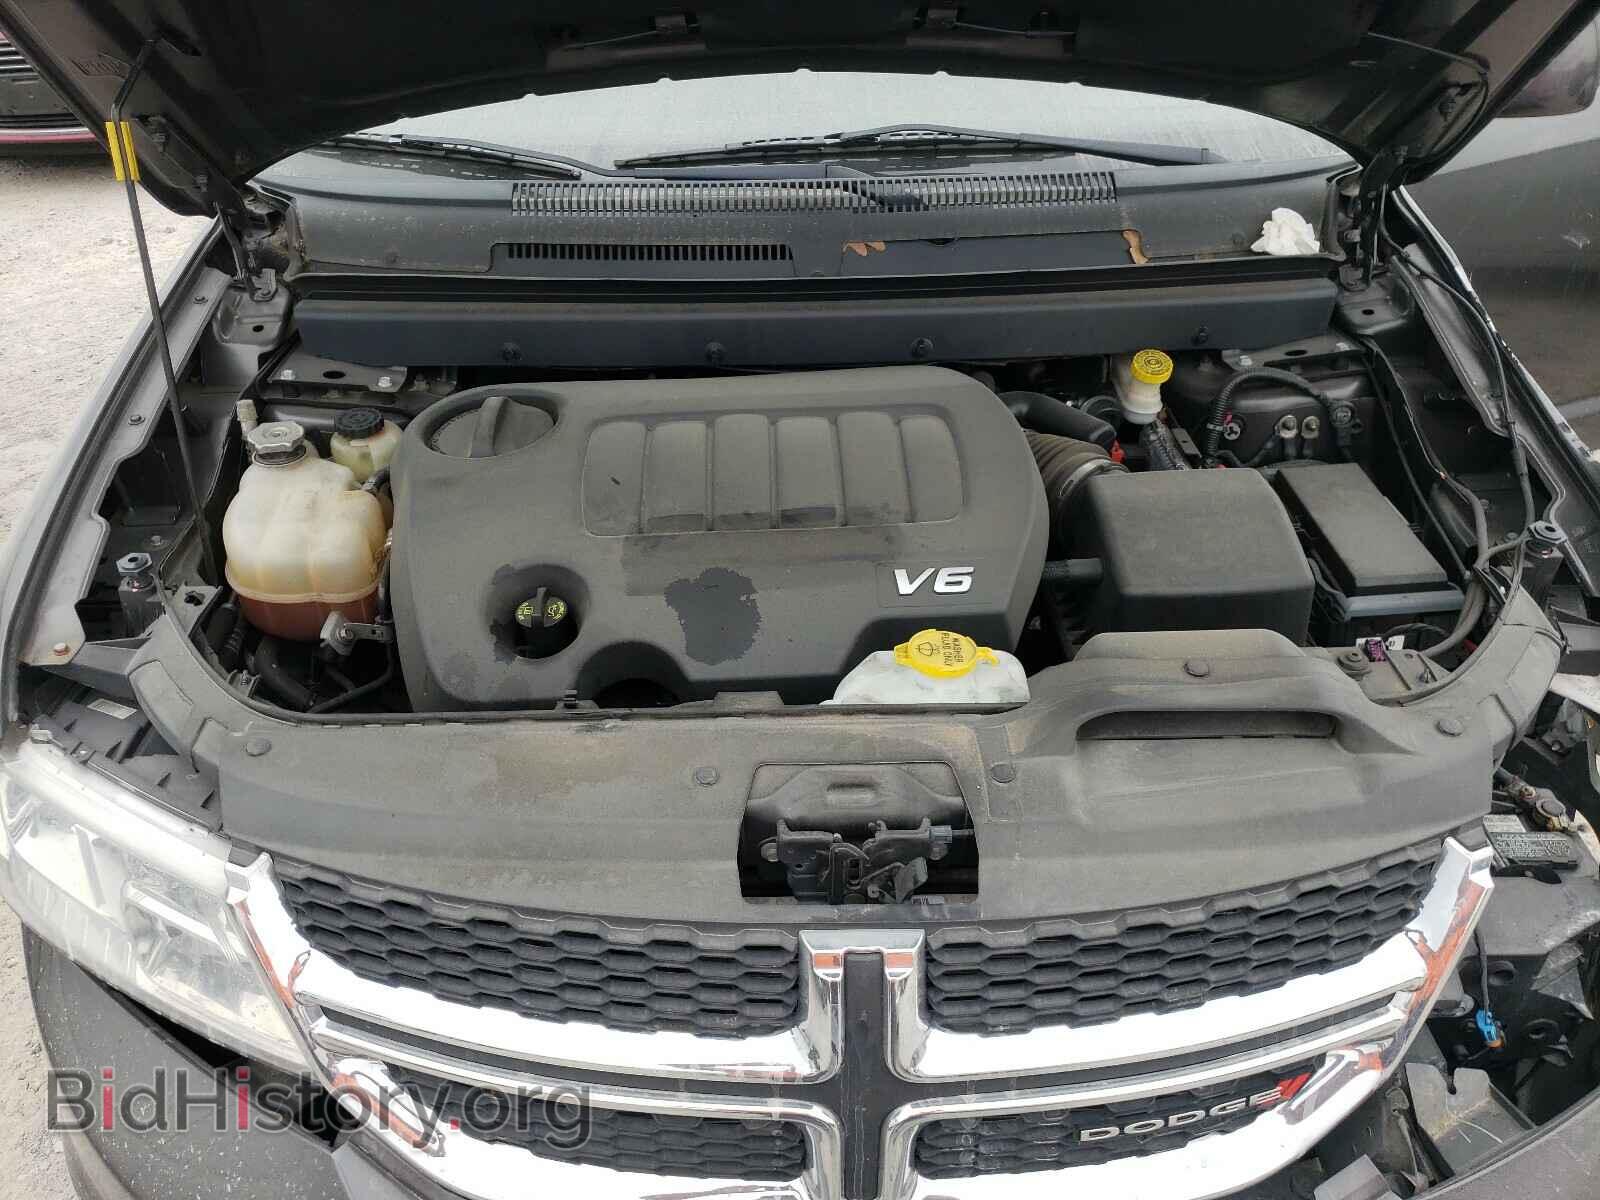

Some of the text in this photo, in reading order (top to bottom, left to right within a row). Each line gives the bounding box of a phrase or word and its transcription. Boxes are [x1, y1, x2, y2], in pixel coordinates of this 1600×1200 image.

[894, 566, 975, 595] V6
[952, 637, 964, 663] WASHER
[1079, 1085, 1284, 1142] DODGE
